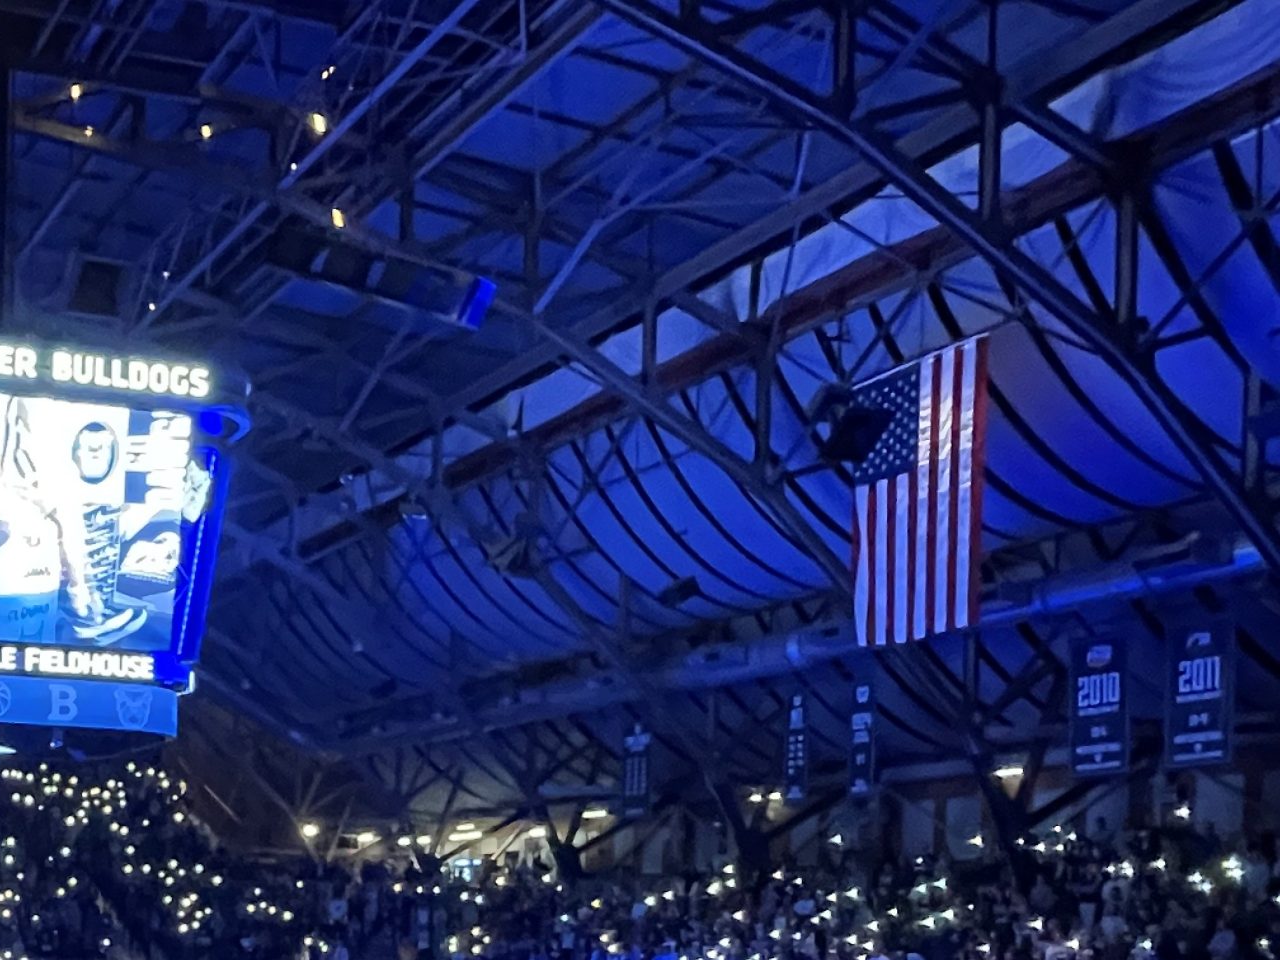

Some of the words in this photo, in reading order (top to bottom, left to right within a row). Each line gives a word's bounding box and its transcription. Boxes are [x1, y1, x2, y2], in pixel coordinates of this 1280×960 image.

[52, 351, 209, 397] BULLDOGS
[24, 646, 154, 679] FIELDHOUSE
[1178, 656, 1220, 693] 2011
[49, 684, 77, 721] B
[1078, 672, 1120, 707] 2010
